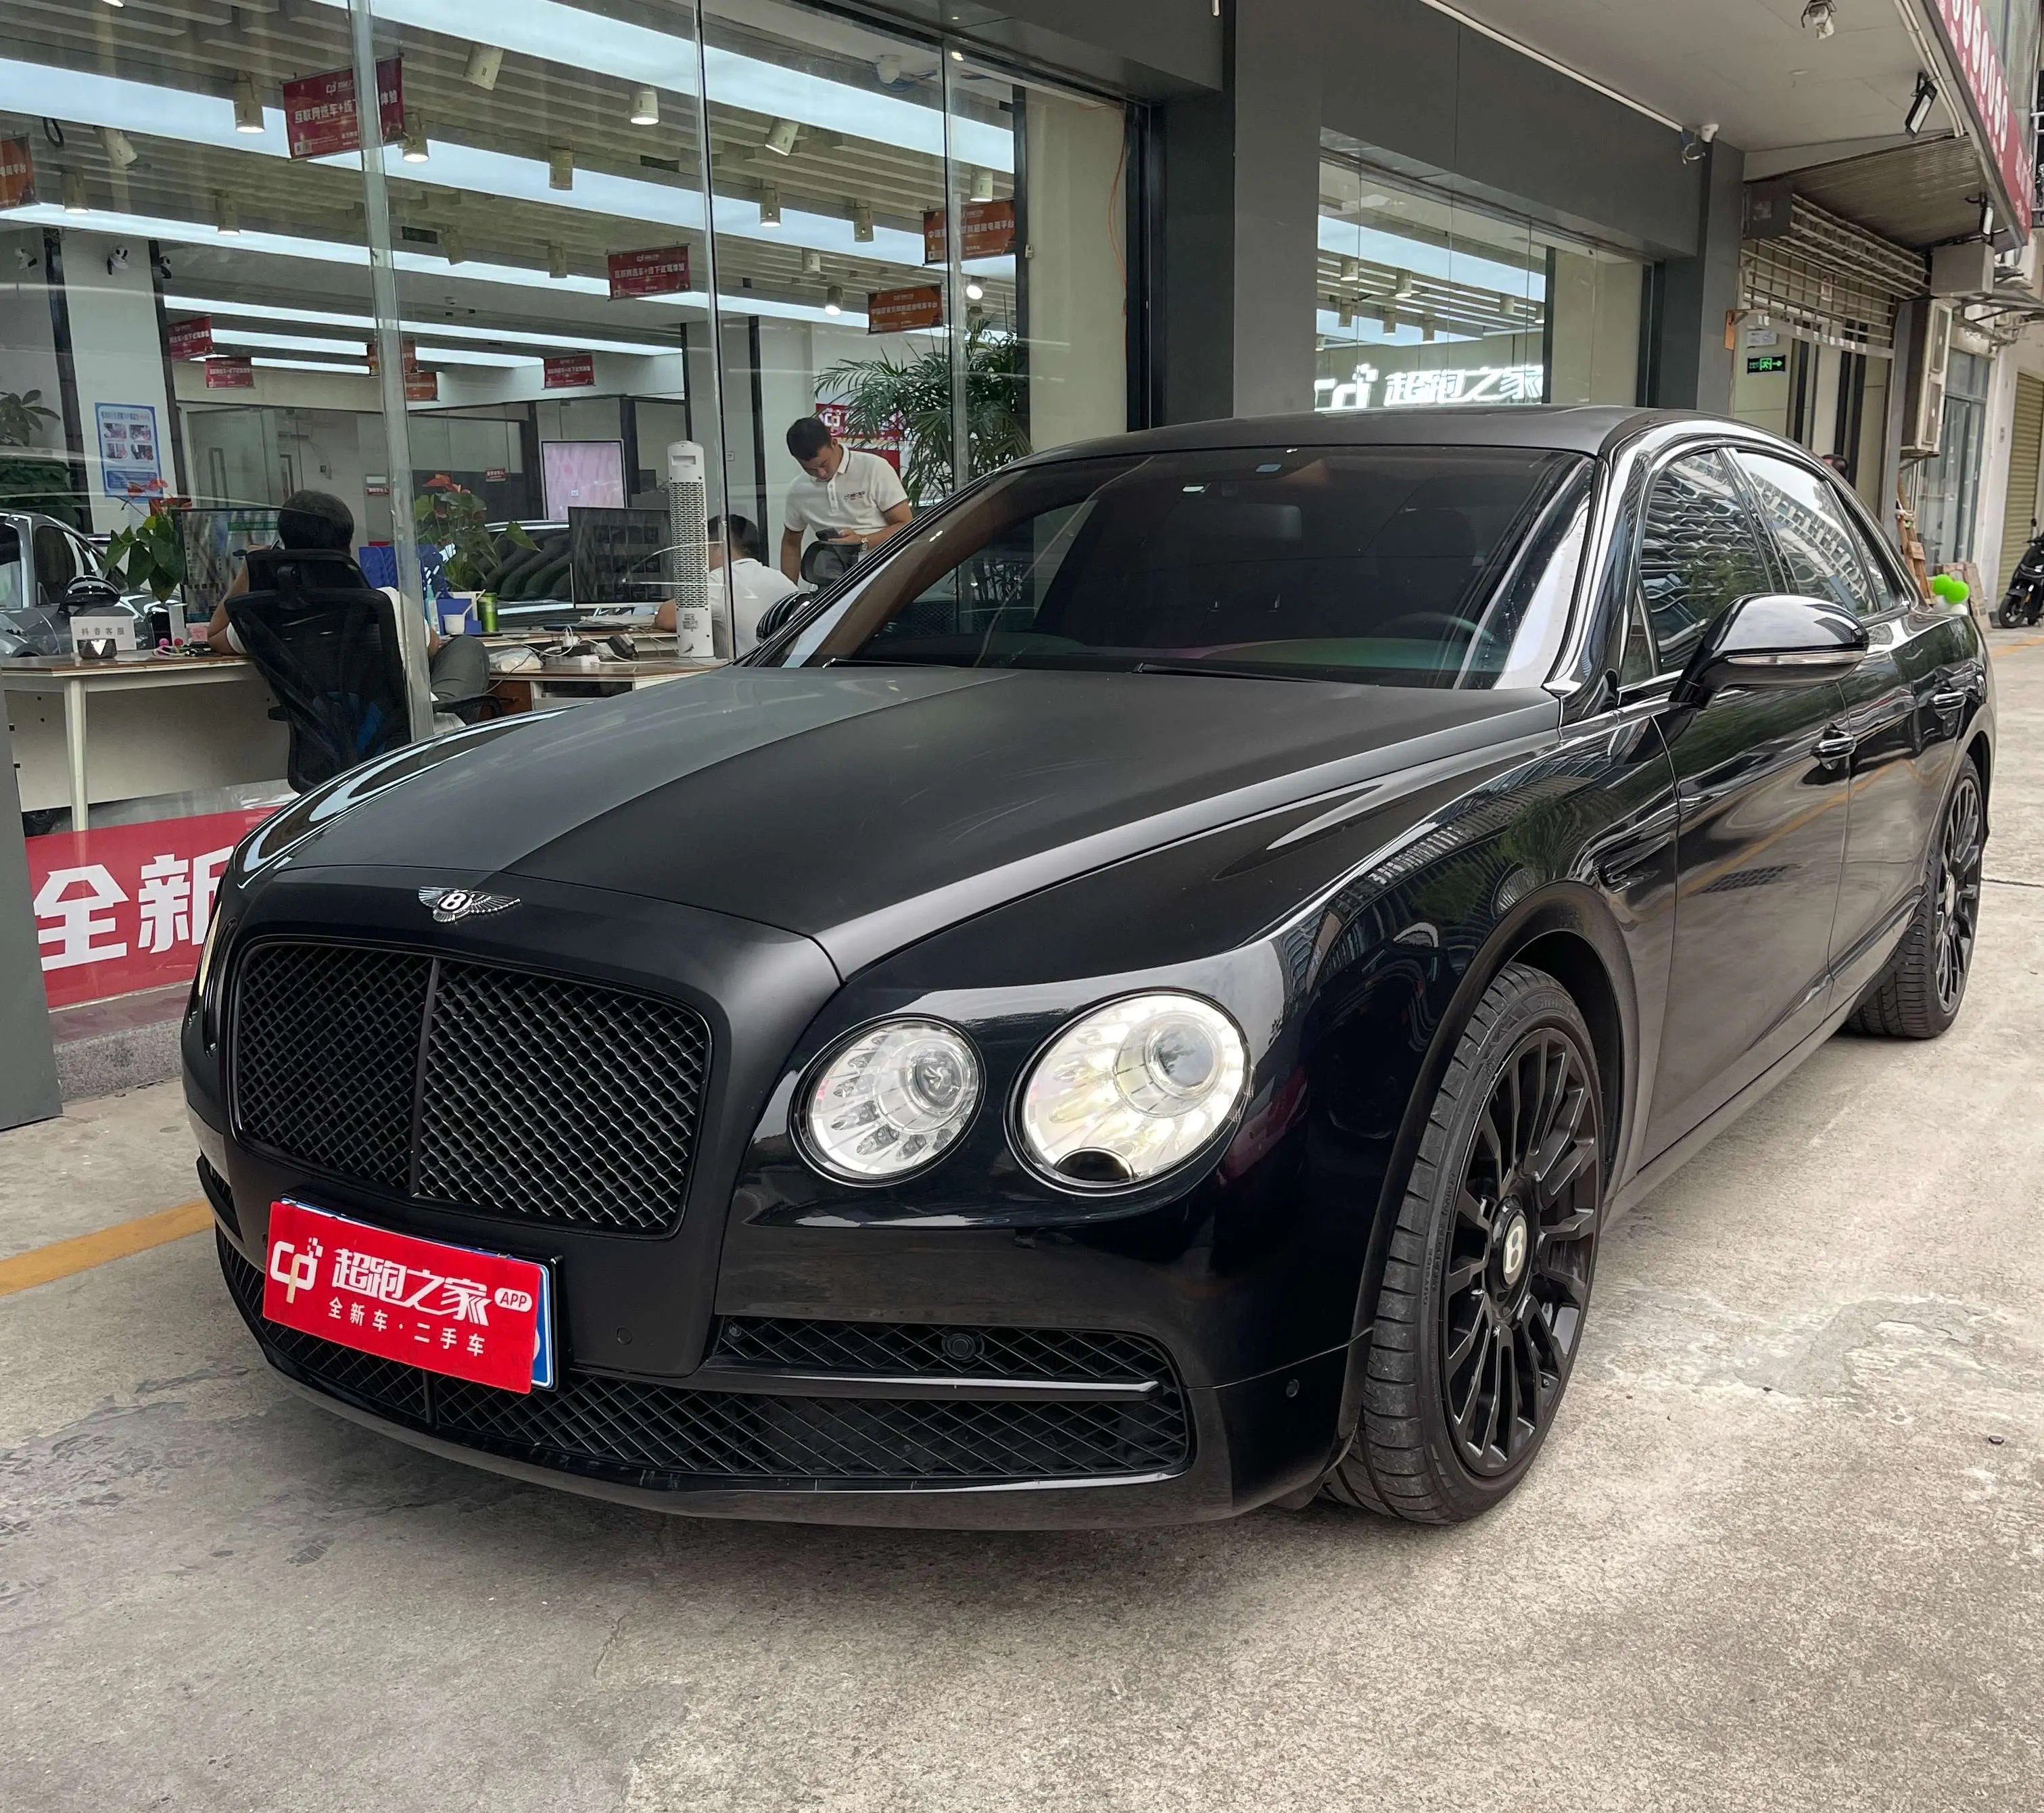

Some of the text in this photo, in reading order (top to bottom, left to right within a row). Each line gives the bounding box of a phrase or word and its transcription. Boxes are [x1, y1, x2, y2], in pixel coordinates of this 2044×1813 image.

[1385, 365, 1543, 406] 超跑之家
[33, 845, 235, 972] 全新
[331, 1248, 528, 1326] 超跑之家 APP
